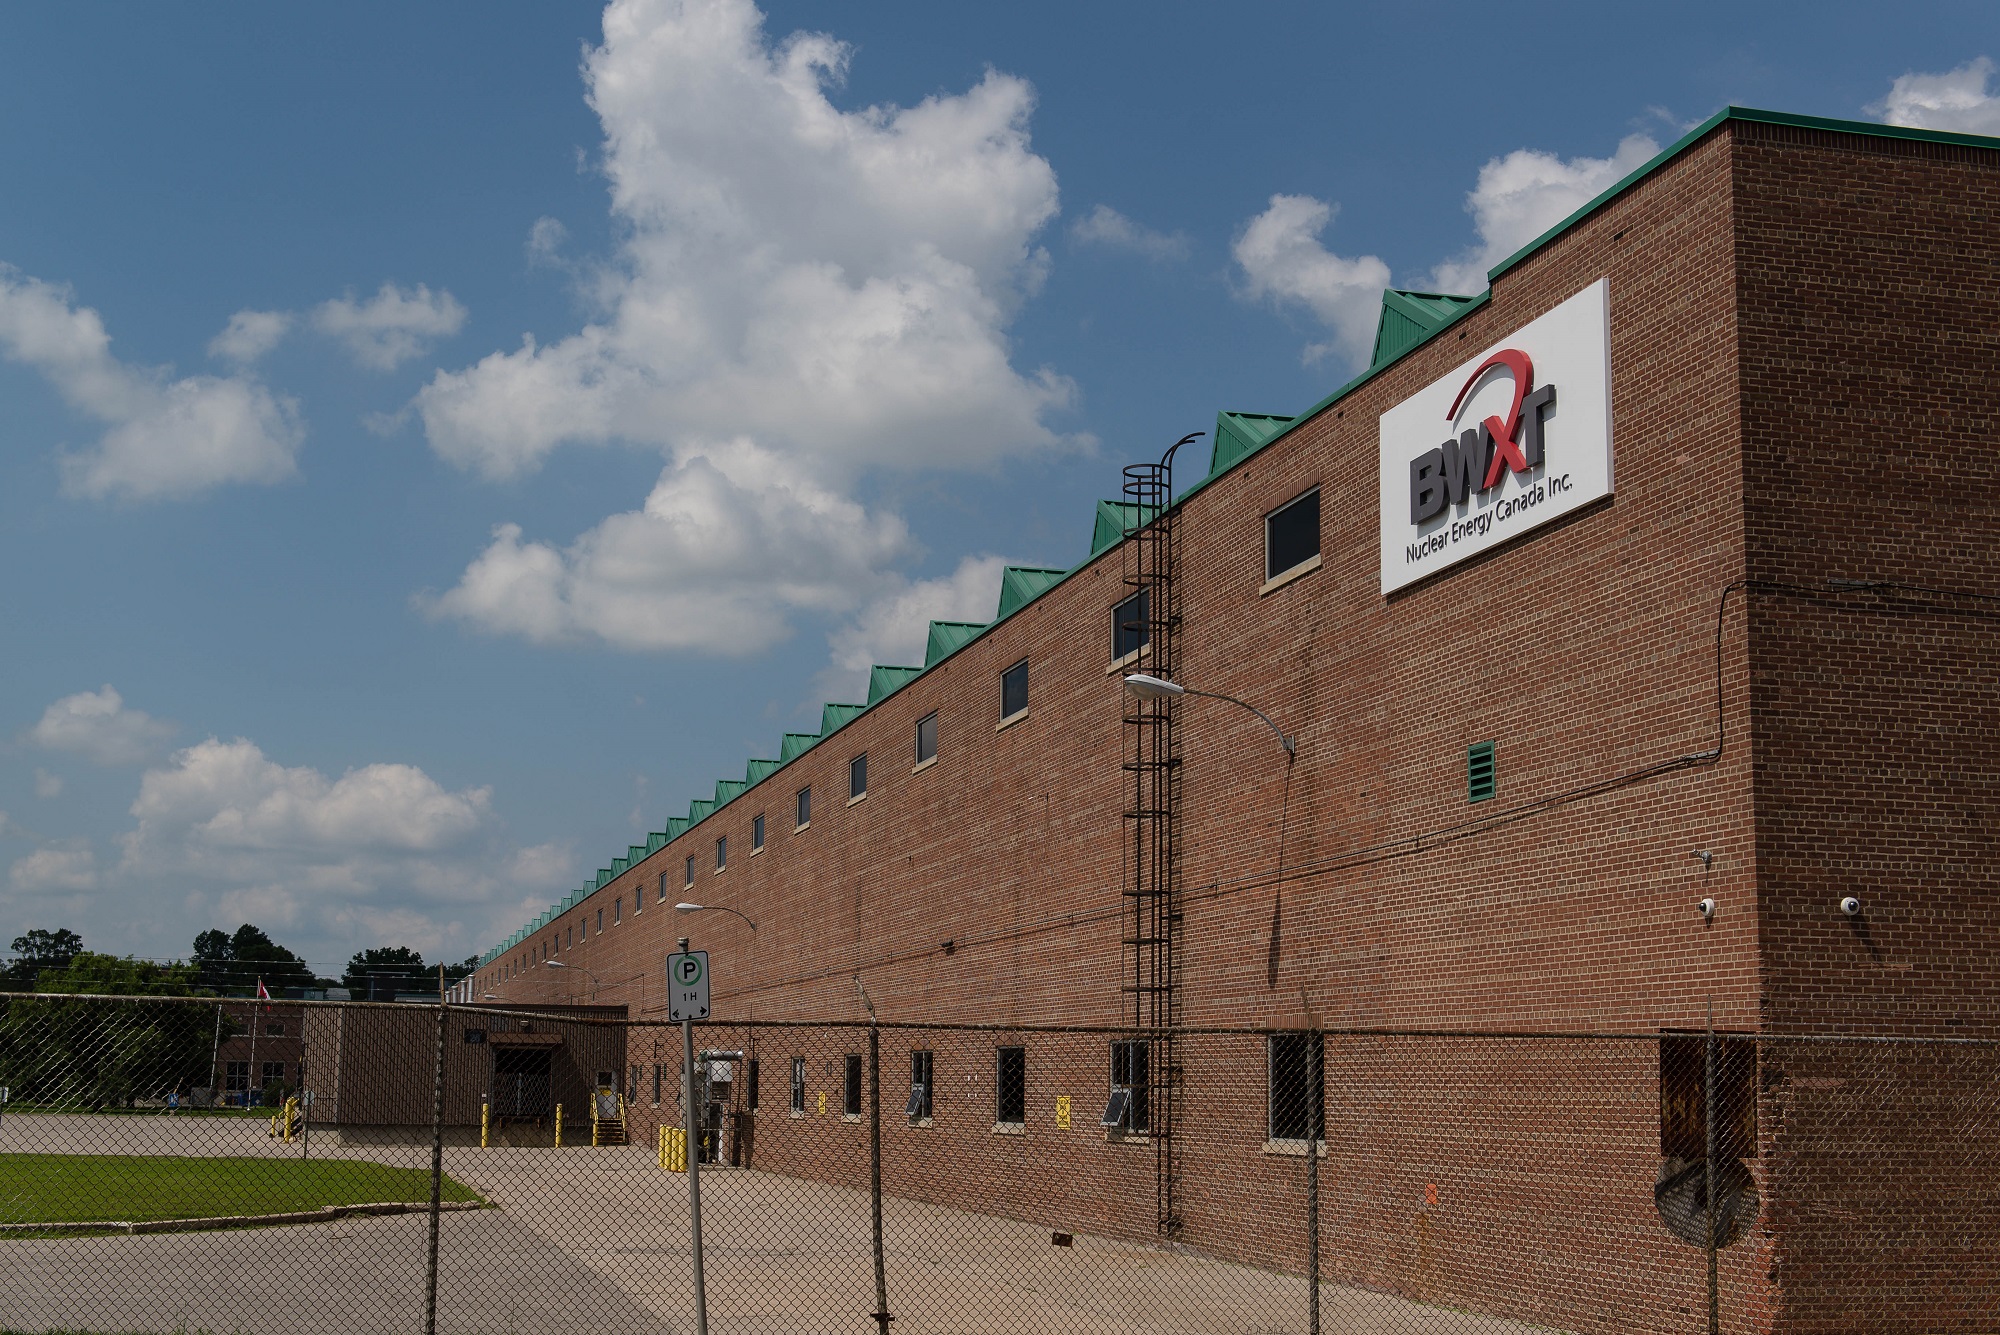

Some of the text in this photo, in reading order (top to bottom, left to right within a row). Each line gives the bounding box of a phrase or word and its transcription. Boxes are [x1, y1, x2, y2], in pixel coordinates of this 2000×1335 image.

[1410, 349, 1556, 526] BWXT
[1406, 473, 1573, 565] Nuclear Energy Canada Inc.
[683, 962, 696, 979] P
